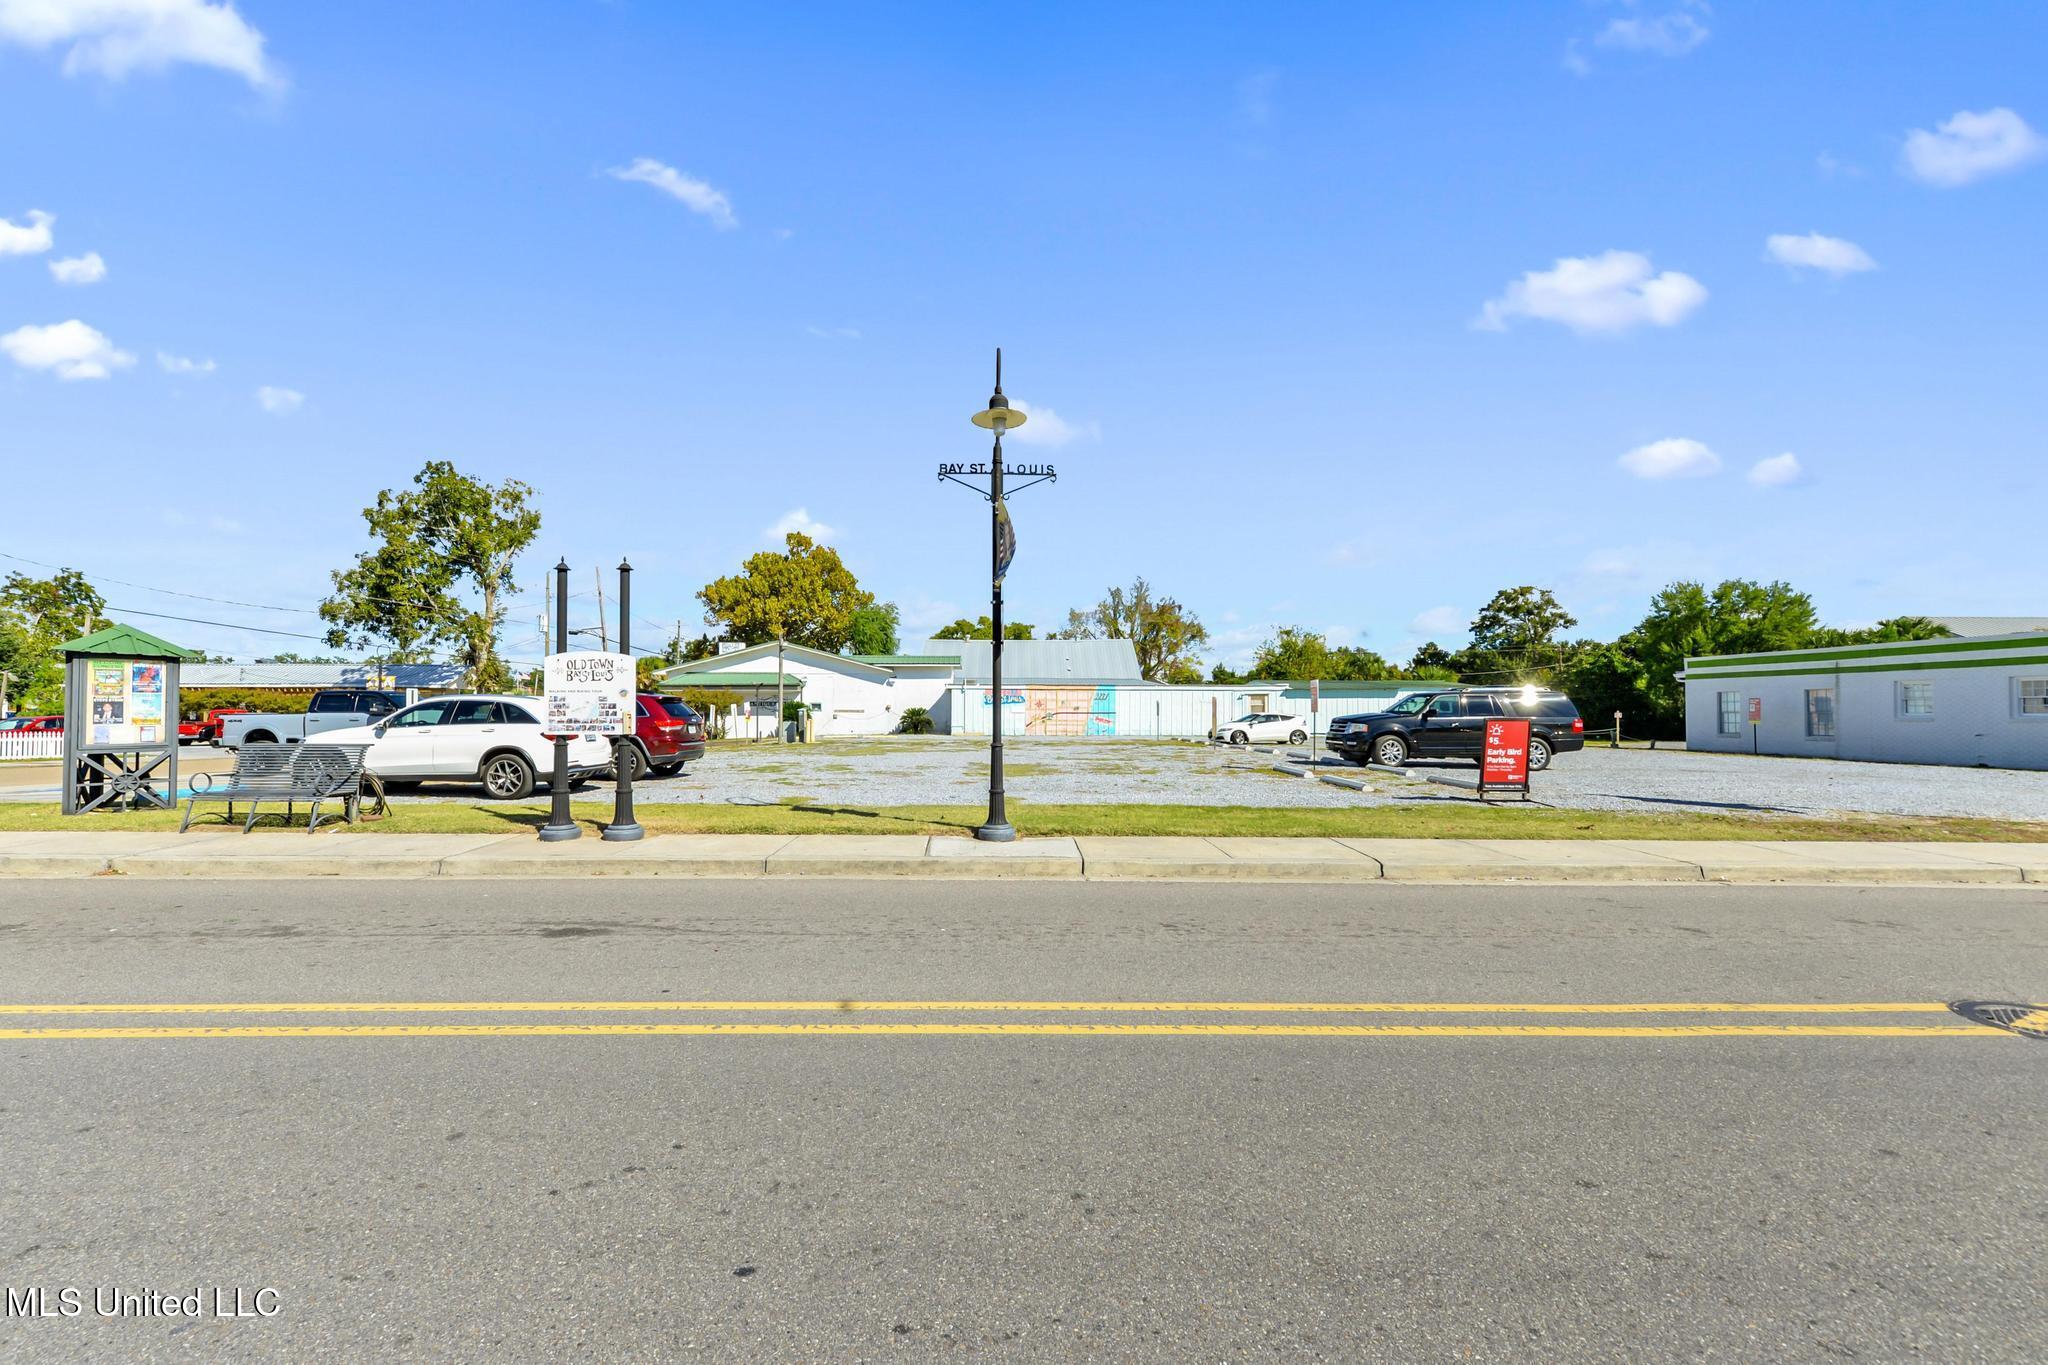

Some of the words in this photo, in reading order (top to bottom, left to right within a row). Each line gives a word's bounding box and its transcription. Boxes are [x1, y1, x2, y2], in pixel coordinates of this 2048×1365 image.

[939, 463, 964, 474] BAY
[1007, 464, 1055, 475] LOUIS
[566, 659, 587, 670] OLD
[587, 658, 614, 670] TOWN
[1488, 736, 1500, 745] $5
[1487, 748, 1506, 757] Early
[1507, 748, 1522, 756] Bird
[1486, 756, 1516, 766] Parking.
